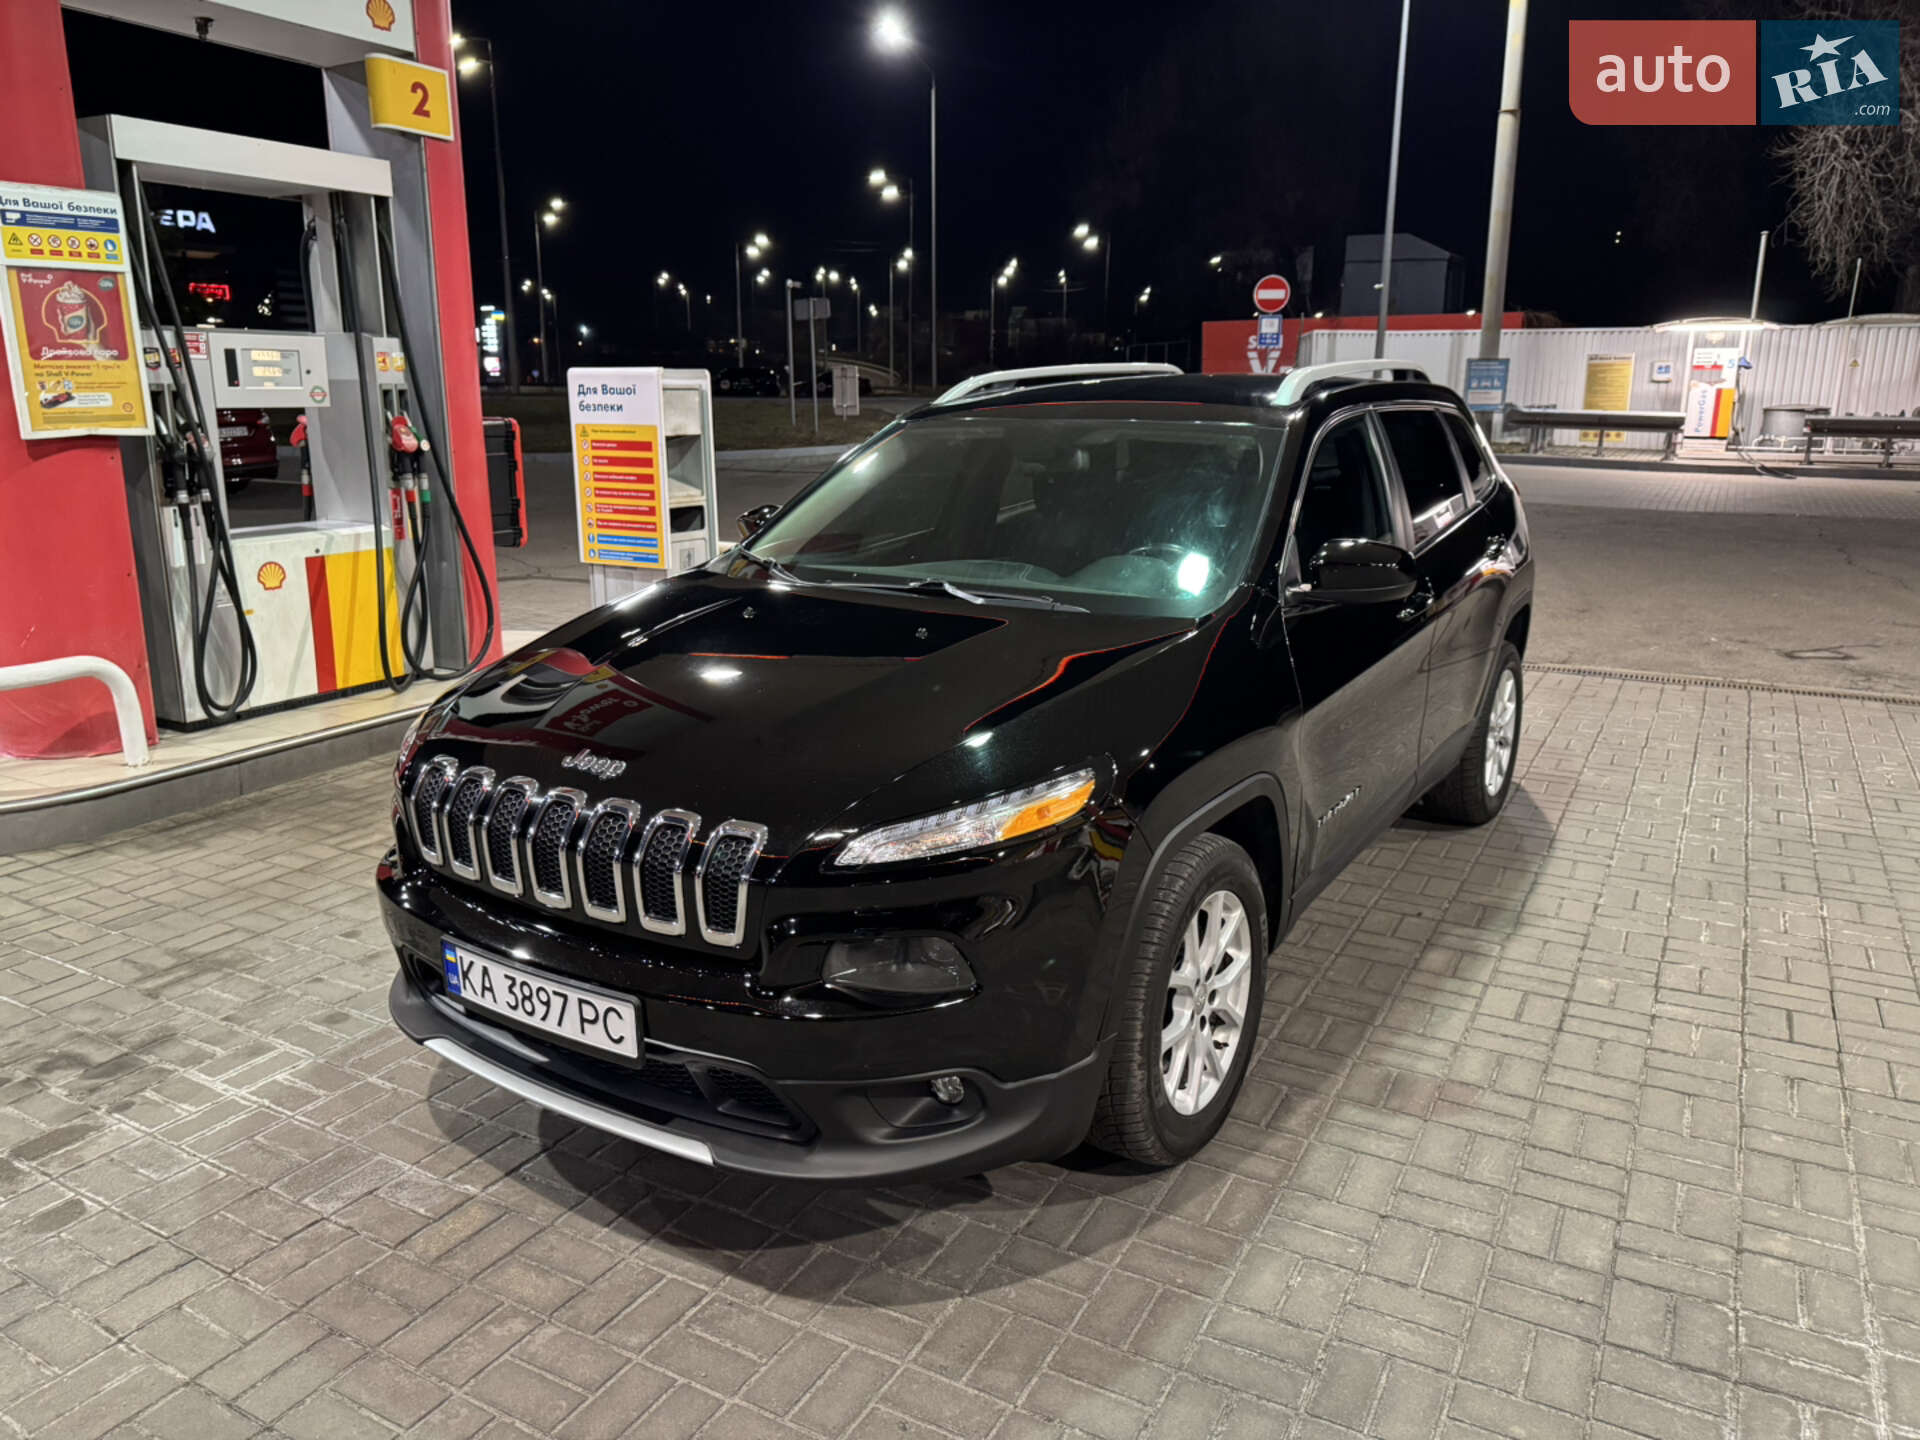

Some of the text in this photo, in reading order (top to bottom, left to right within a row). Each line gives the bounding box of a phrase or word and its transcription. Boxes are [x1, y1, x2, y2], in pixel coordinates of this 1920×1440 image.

[409, 81, 431, 119] 2
[22, 197, 63, 211] Вашої
[67, 201, 118, 215] безпеки
[577, 384, 637, 397] Для Вашої
[579, 400, 624, 413] безпеки
[561, 748, 627, 779] Jeep
[460, 956, 625, 1045] KA 3897 PC
